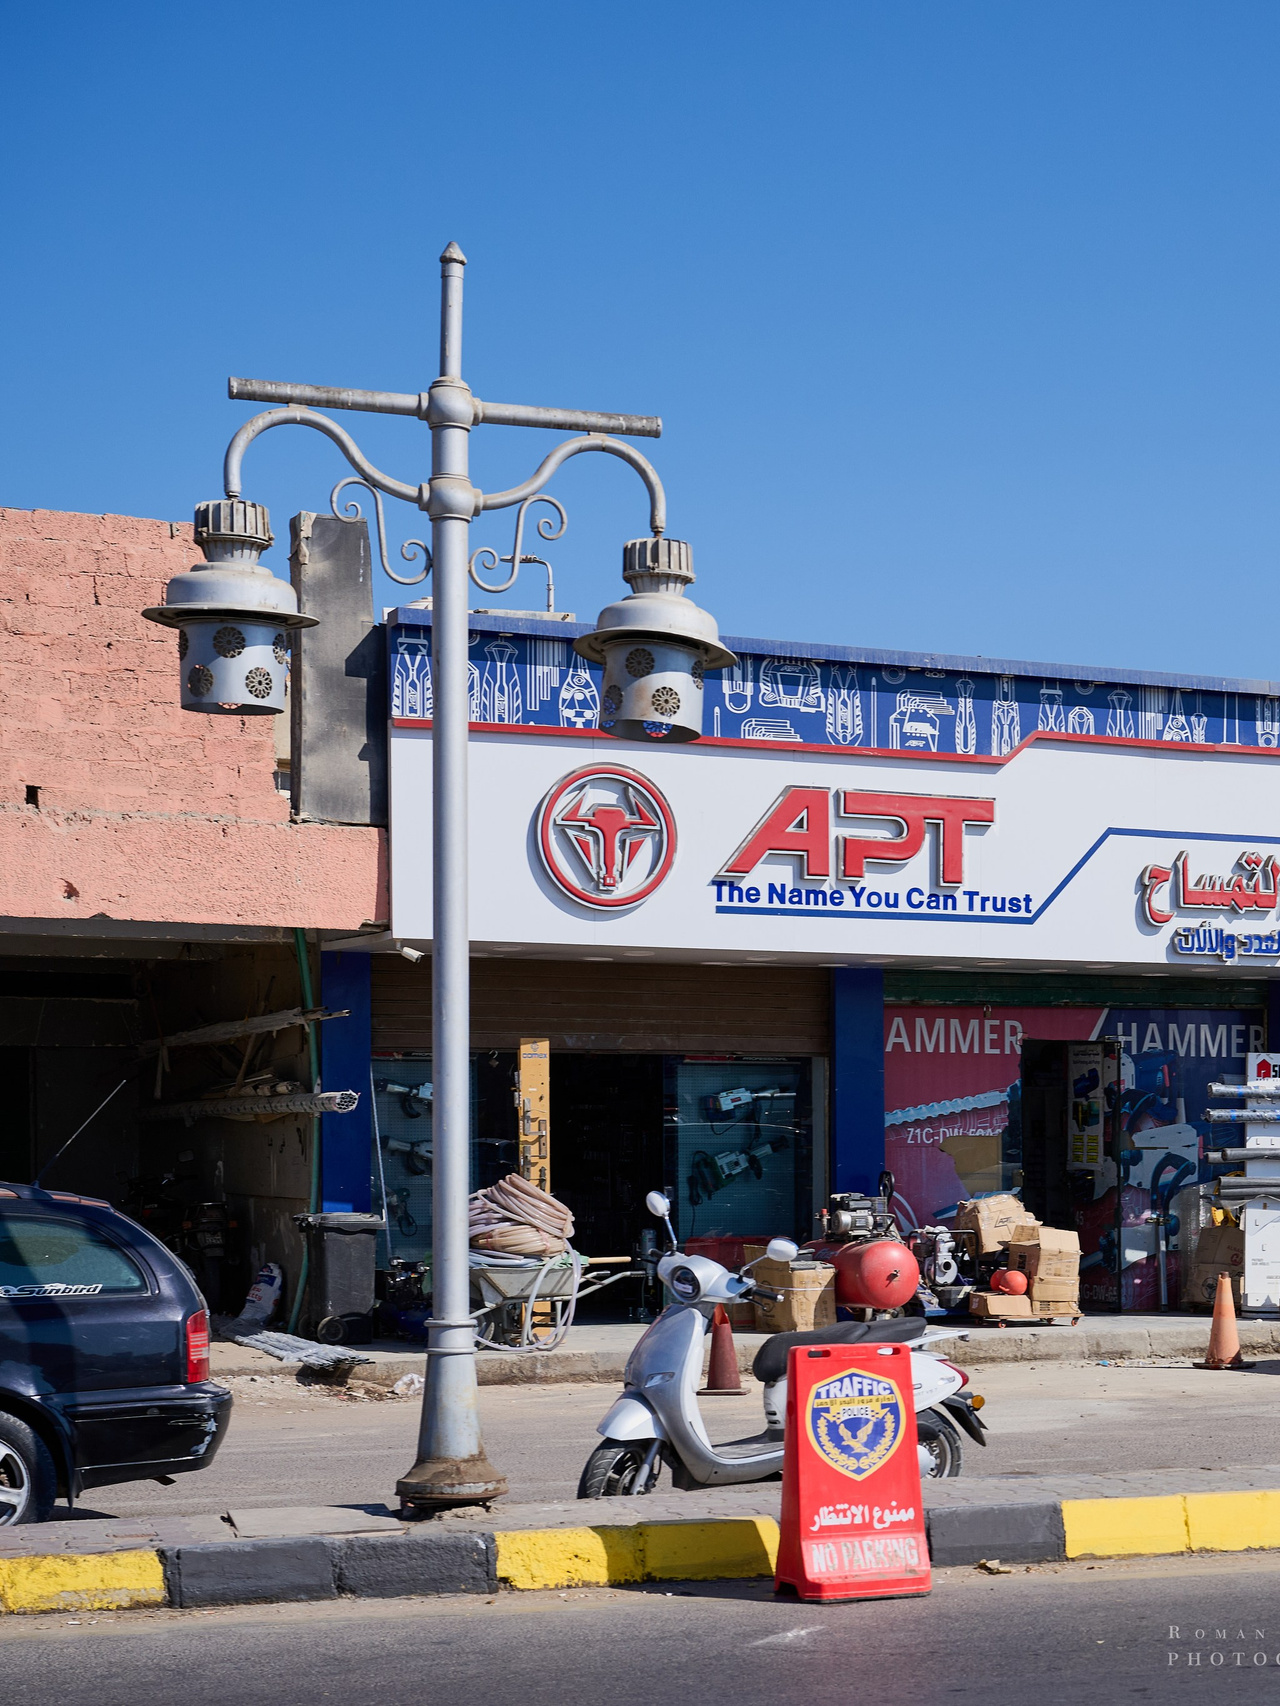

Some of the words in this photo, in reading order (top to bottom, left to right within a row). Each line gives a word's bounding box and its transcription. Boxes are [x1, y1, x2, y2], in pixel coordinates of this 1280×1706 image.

[714, 784, 996, 888] APT
[713, 880, 762, 904] The
[767, 884, 845, 907] Name
[849, 886, 899, 909] You
[905, 887, 955, 911] Can
[963, 890, 1033, 915] Trust
[1117, 1022, 1265, 1058] HAMMER
[12, 1284, 100, 1296] Sunbird
[817, 1376, 891, 1399] TRAFFIC
[842, 1406, 869, 1418] POLICE
[871, 1500, 915, 1530] ممنوع
[811, 1542, 839, 1573] NO
[843, 1537, 919, 1572] PARKING
